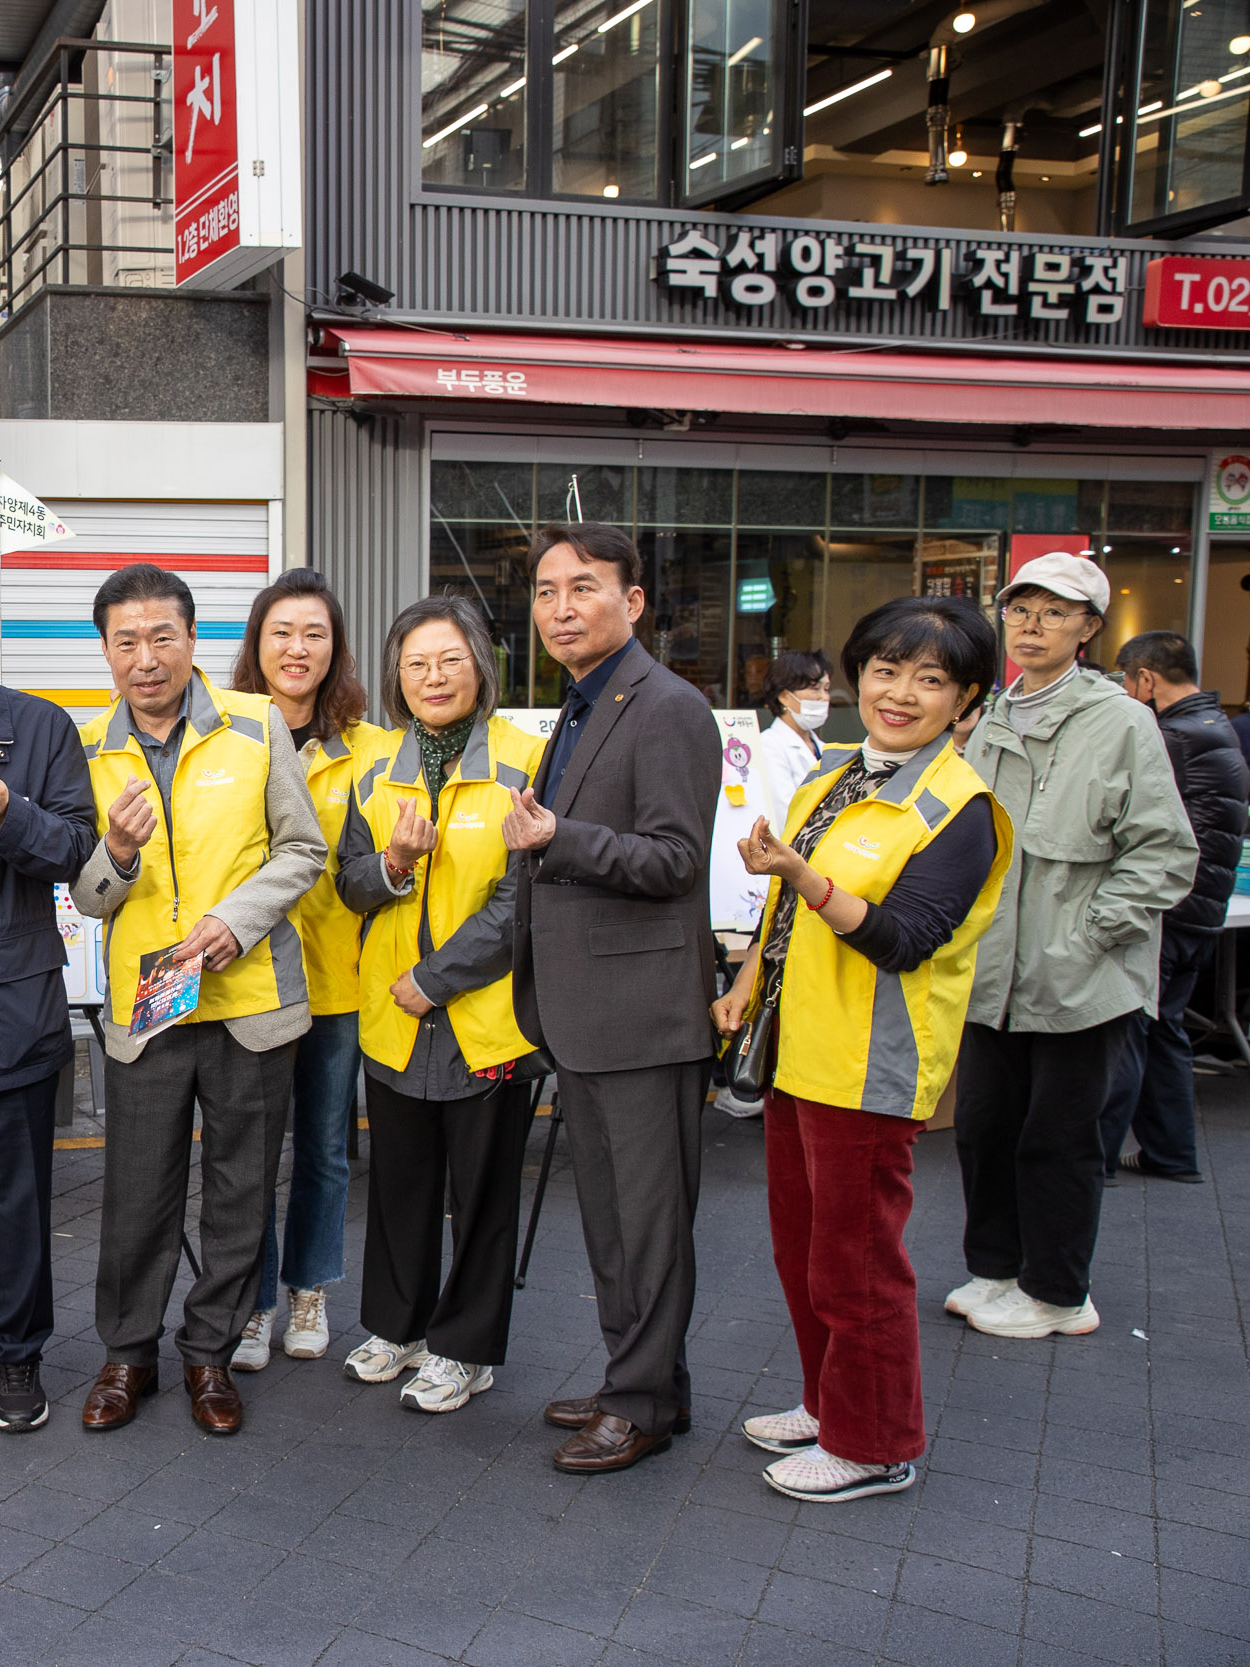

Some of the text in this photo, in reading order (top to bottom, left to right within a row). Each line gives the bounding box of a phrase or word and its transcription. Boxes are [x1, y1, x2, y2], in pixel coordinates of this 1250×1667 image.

[199, 191, 239, 251] 단체환영
[972, 249, 1128, 324] 전문점
[1174, 272, 1250, 316] T.02
[436, 368, 528, 396] 부두풍운
[0, 514, 46, 540] 주민자치회
